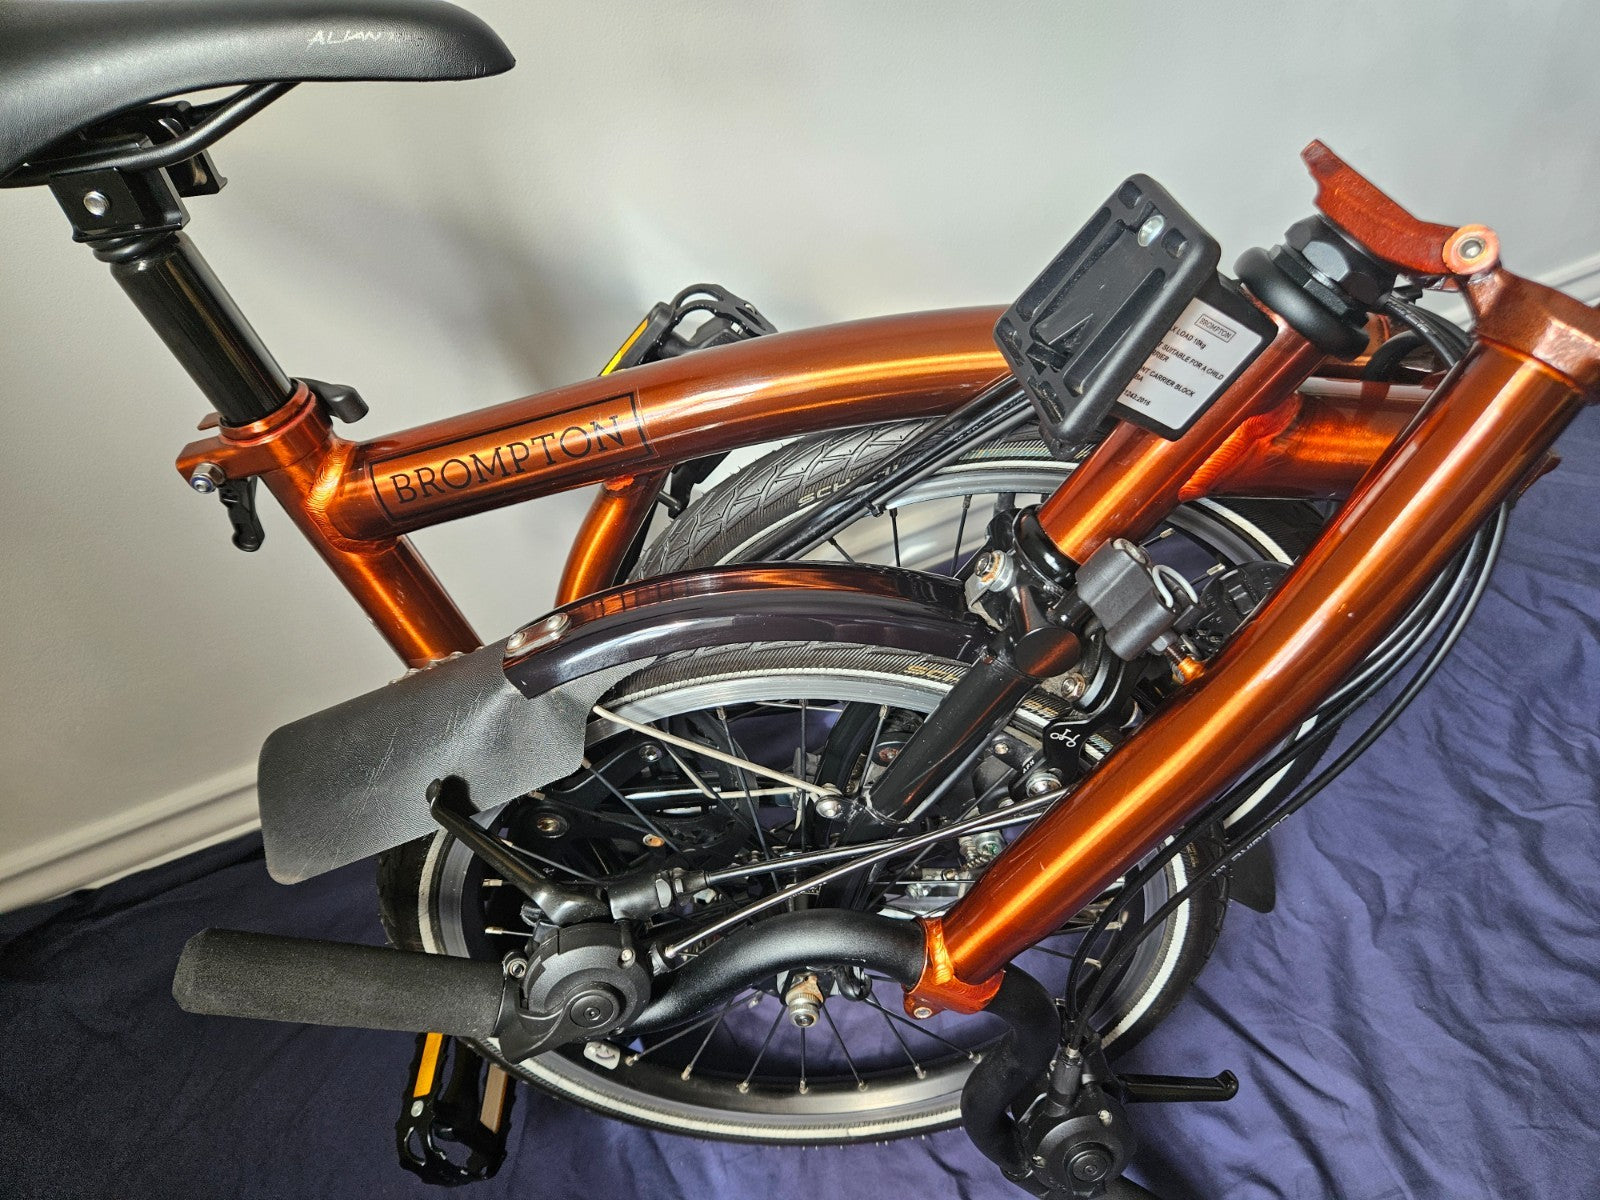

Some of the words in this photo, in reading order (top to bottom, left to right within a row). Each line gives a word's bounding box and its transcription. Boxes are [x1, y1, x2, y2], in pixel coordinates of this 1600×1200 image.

[1176, 328, 1194, 341] LOAD
[1199, 317, 1232, 339] BROMPTON
[1151, 349, 1170, 363] RRIER
[1161, 344, 1191, 363] SUITABLE
[1189, 358, 1203, 370] FOR
[1206, 368, 1225, 380] CHILD
[1149, 370, 1176, 388] CARRIER
[1174, 383, 1196, 397] BLOCK
[389, 414, 625, 504] BROMPTON
